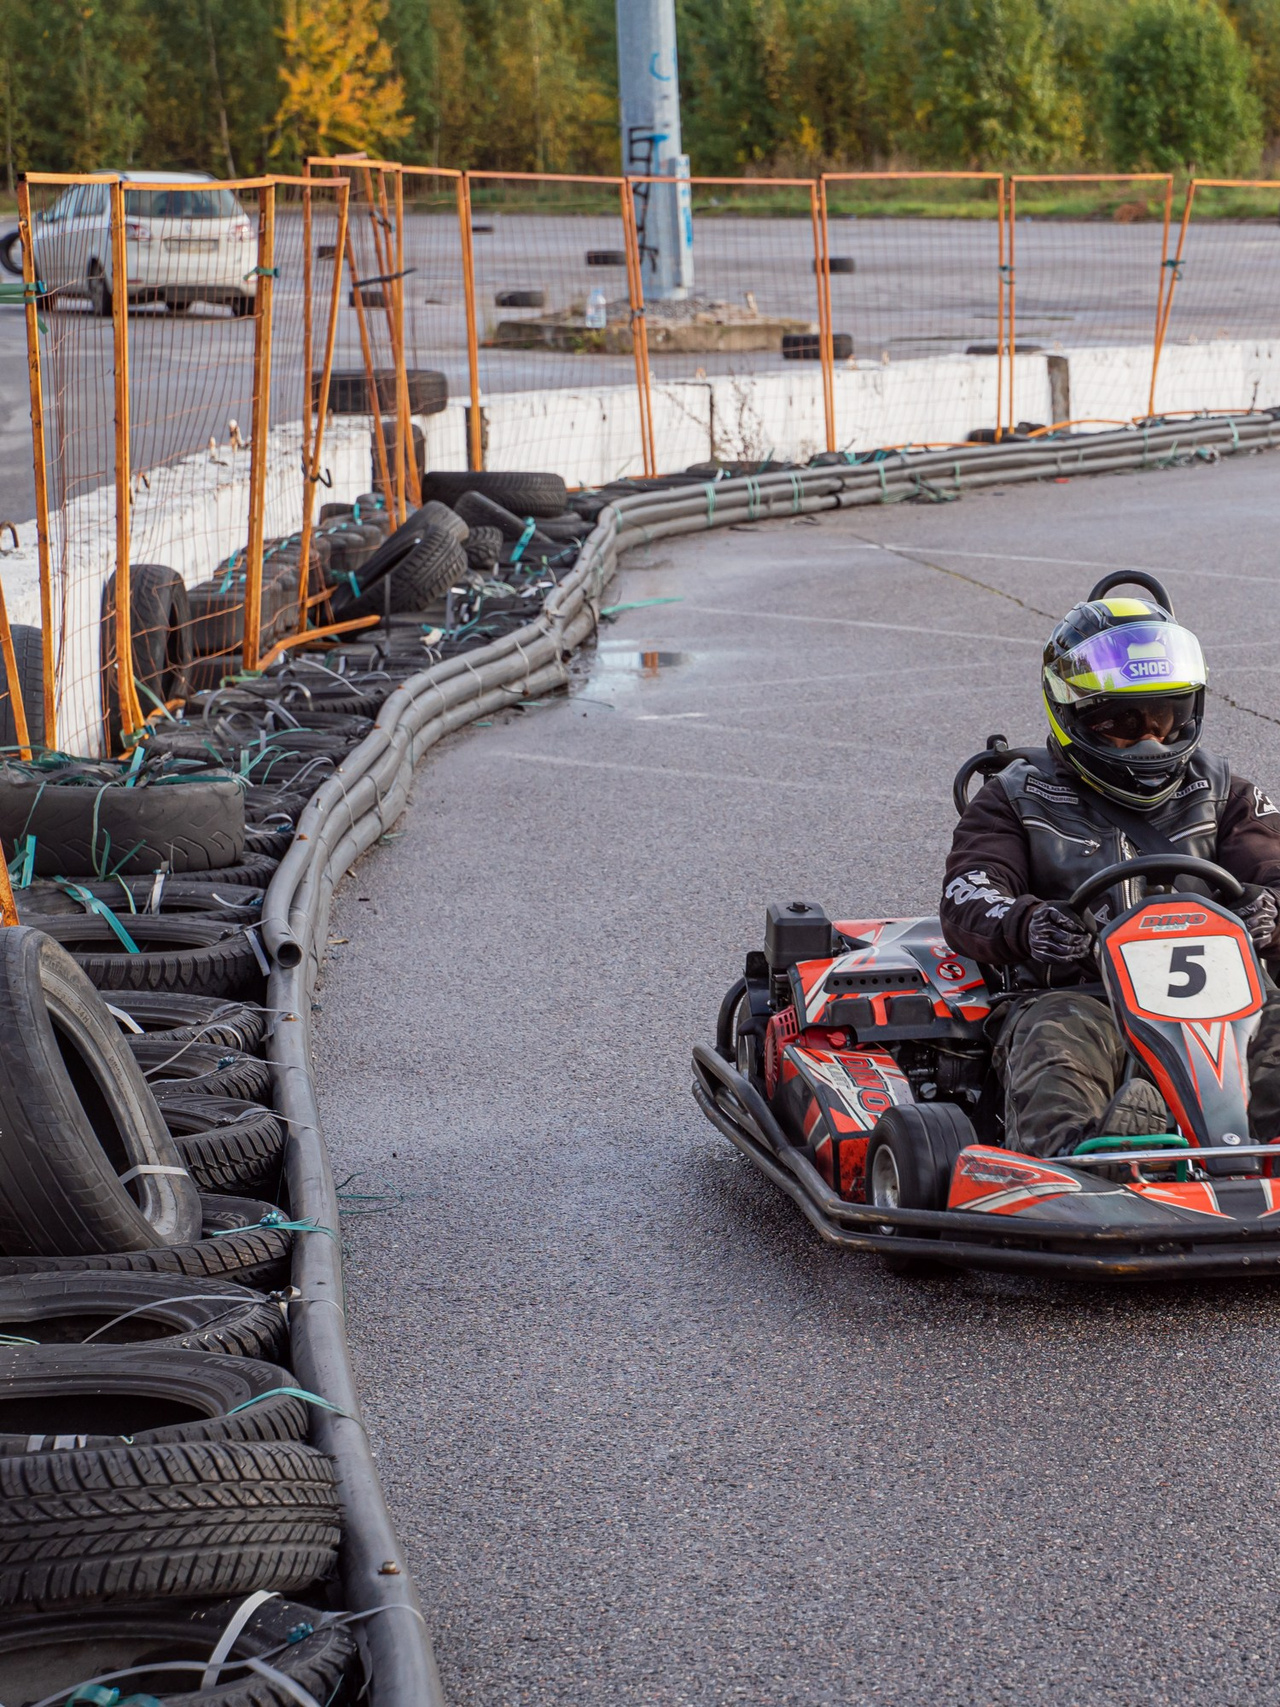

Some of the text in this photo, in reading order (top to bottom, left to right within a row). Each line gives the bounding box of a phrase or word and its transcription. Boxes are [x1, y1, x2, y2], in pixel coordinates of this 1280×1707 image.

[1129, 661, 1170, 677] SHOEI
[1140, 913, 1207, 928] DINO
[1167, 945, 1207, 998] 5
[834, 1055, 896, 1116] DINO
